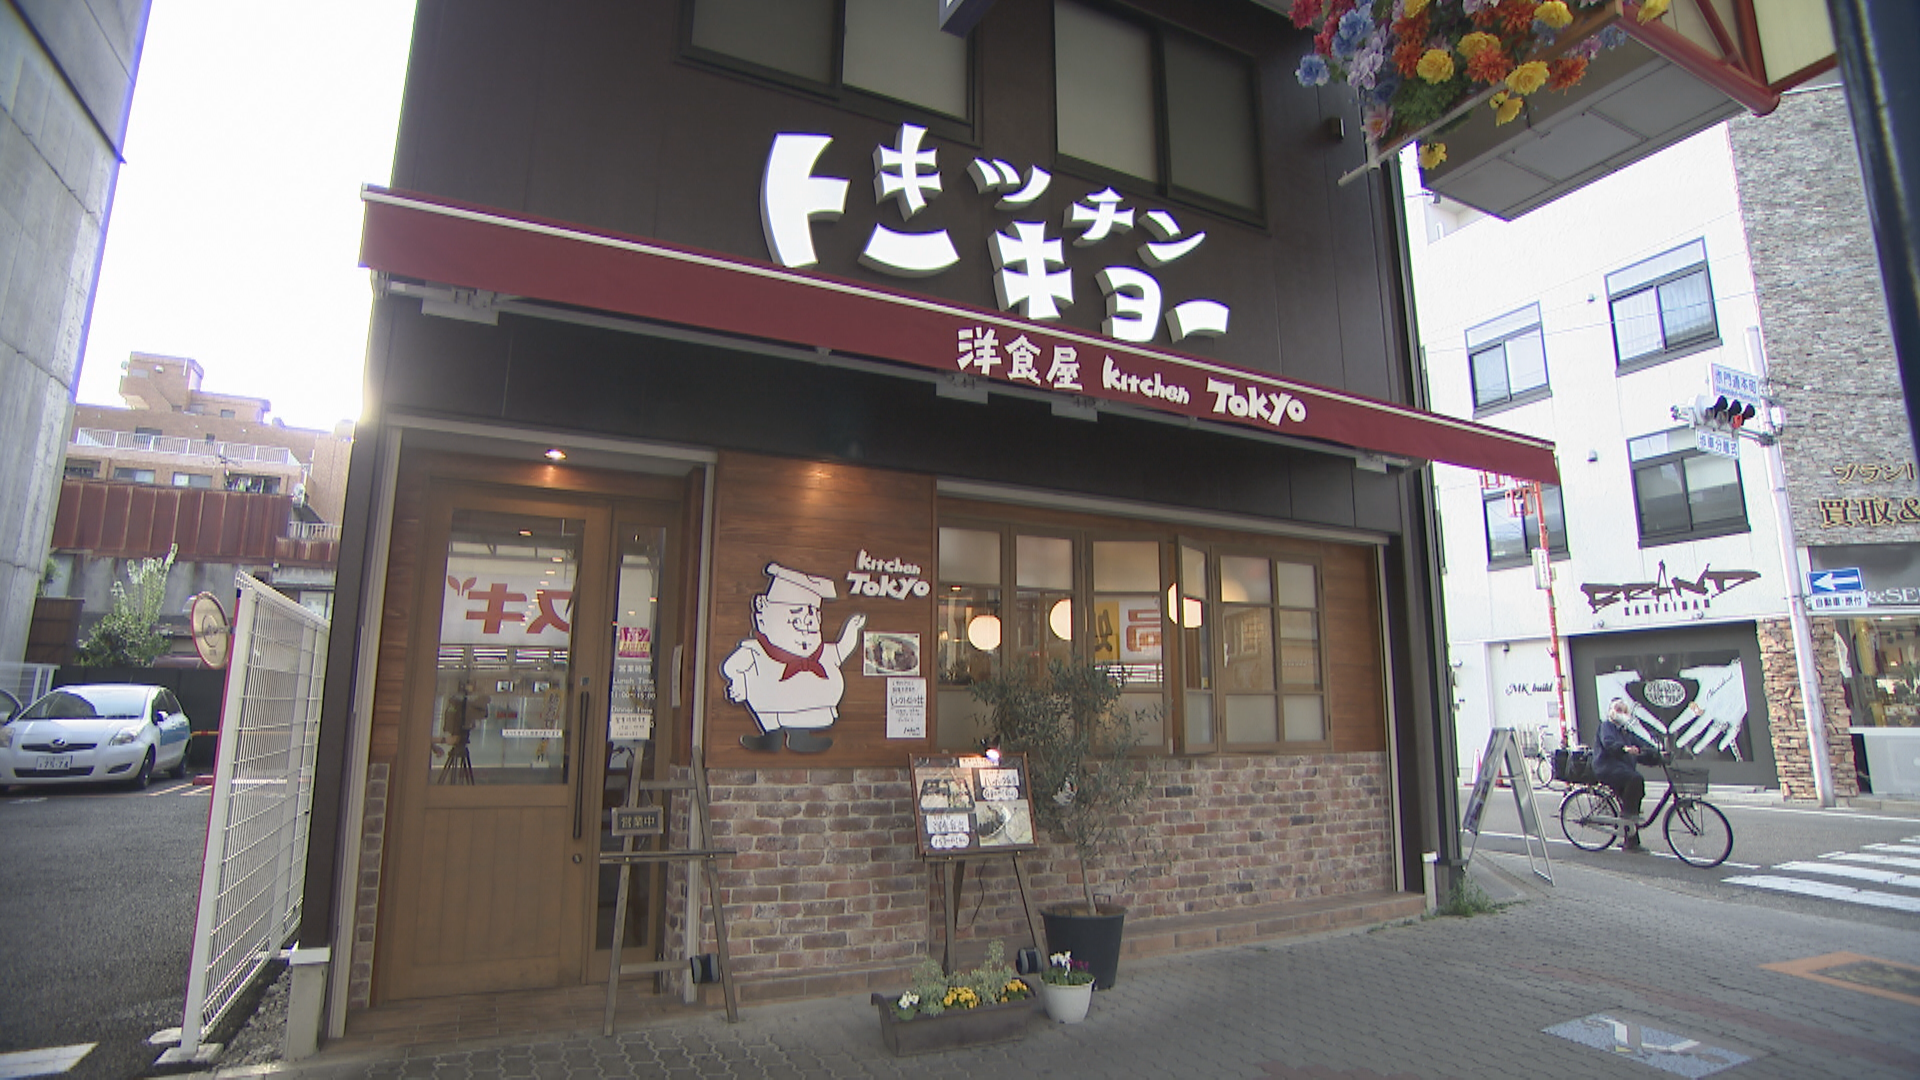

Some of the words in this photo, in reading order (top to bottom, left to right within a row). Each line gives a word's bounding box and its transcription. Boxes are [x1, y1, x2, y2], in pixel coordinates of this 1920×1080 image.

[956, 326, 1084, 392] 洋食屋
[1206, 377, 1307, 426] Tokyo
[846, 571, 931, 600] Tokyo
[1580, 559, 1762, 614] BRAND
[621, 815, 656, 828] 営業中
